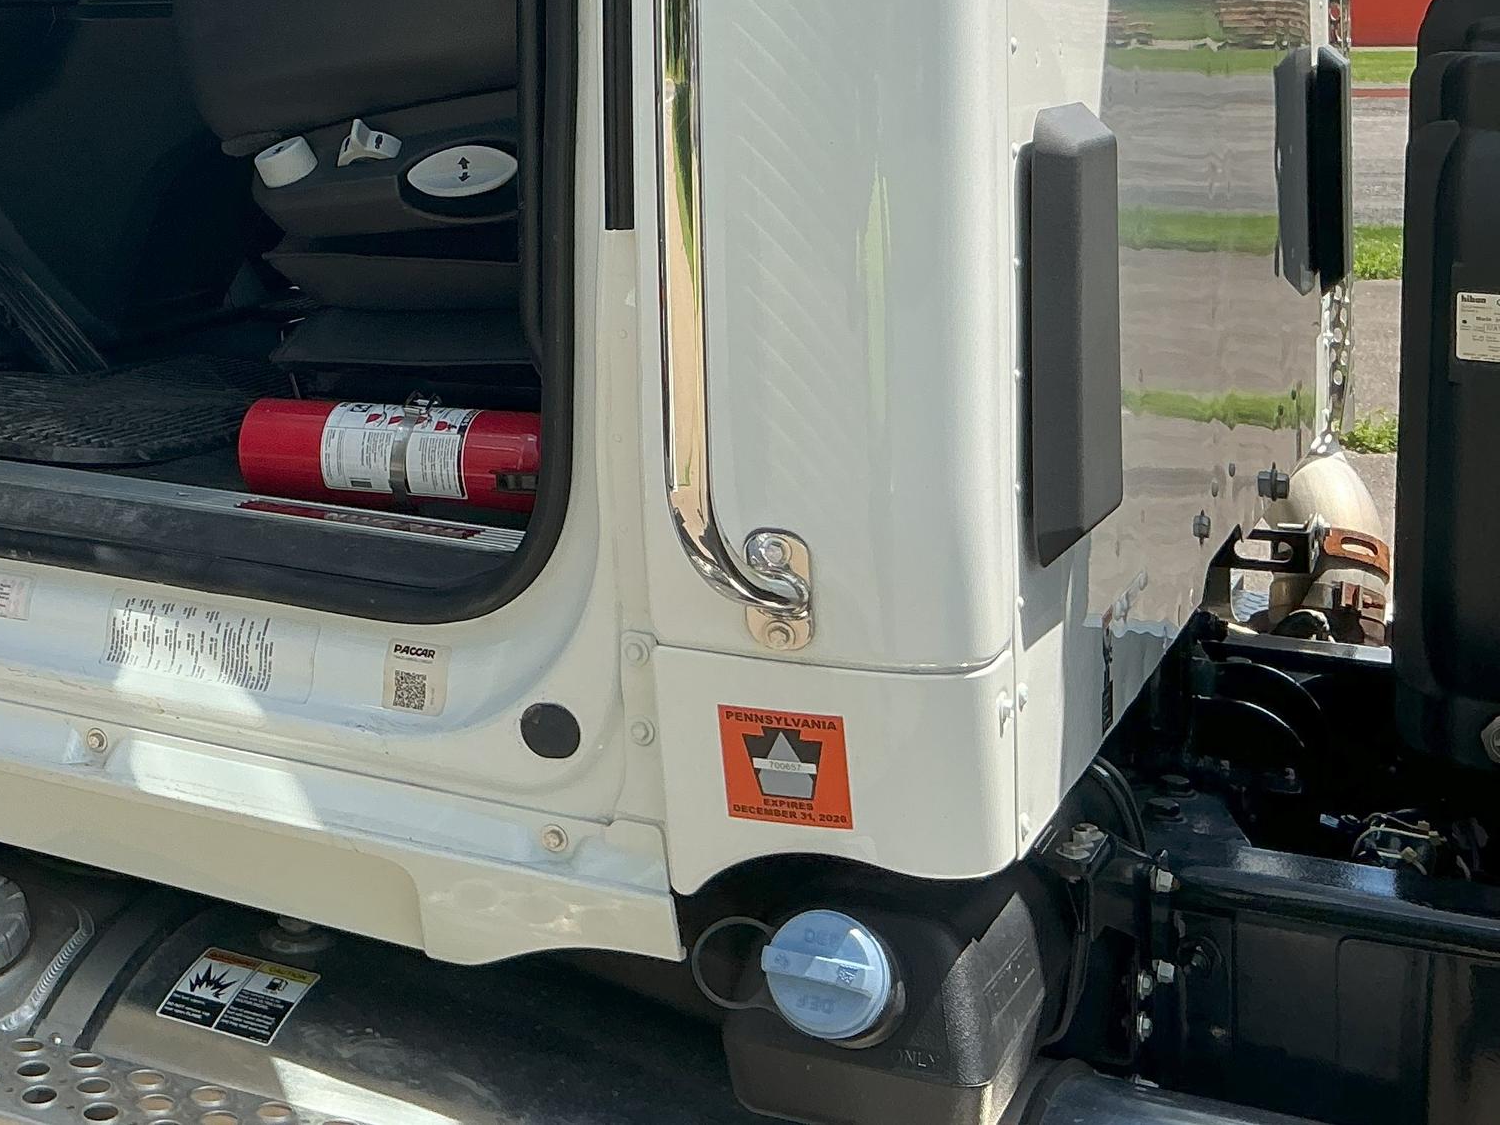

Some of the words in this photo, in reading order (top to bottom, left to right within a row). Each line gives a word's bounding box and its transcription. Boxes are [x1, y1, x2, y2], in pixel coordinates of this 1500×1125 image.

[394, 644, 436, 659] PACCAR
[725, 710, 838, 731] PENNSYLVANIA
[763, 798, 815, 811] EXPIRES
[733, 804, 798, 820] DECEMBER
[800, 811, 817, 823] 31,
